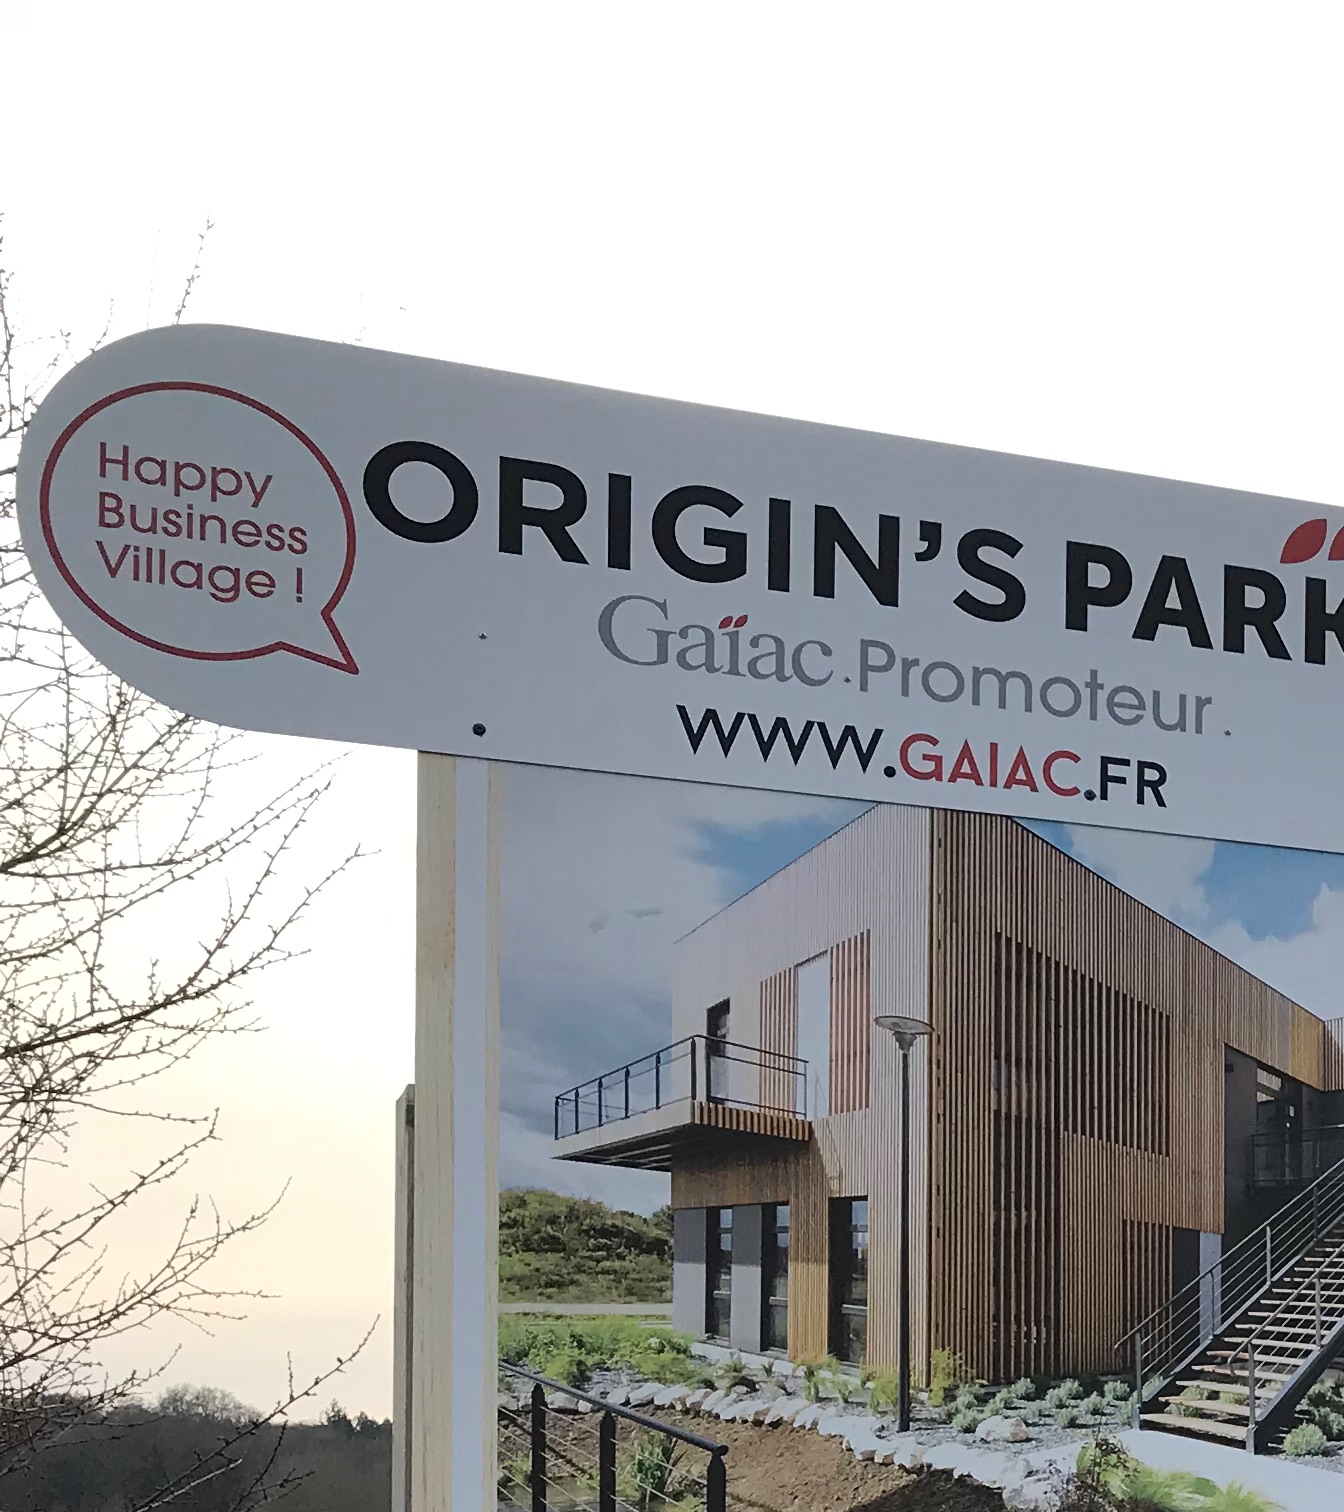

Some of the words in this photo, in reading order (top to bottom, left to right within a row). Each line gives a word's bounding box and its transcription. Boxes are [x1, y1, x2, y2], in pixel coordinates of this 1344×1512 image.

[98, 441, 273, 508] Happy
[98, 491, 309, 555] Business
[362, 440, 1027, 623] ORIGIN'S
[95, 540, 276, 603] Village
[295, 566, 305, 604] !
[597, 594, 835, 688] Gaïac
[859, 638, 1213, 735] Promoteur
